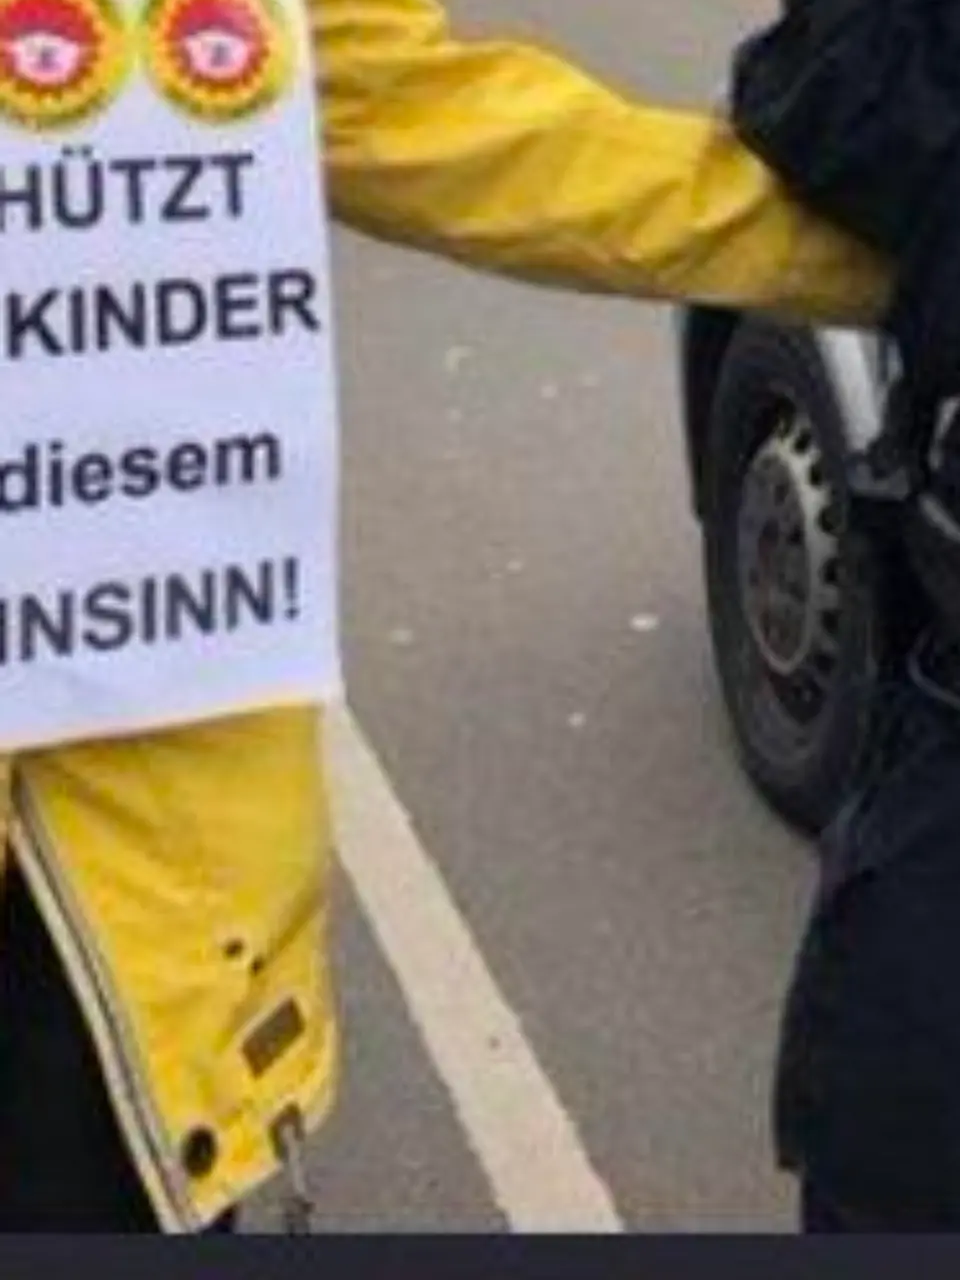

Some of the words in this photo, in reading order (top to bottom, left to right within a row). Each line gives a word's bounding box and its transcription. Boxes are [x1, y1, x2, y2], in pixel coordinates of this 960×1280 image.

[0, 145, 254, 232] HÜTZT
[5, 268, 320, 361] KINDER
[0, 432, 281, 513] diesem
[0, 556, 300, 667] NSINN!
